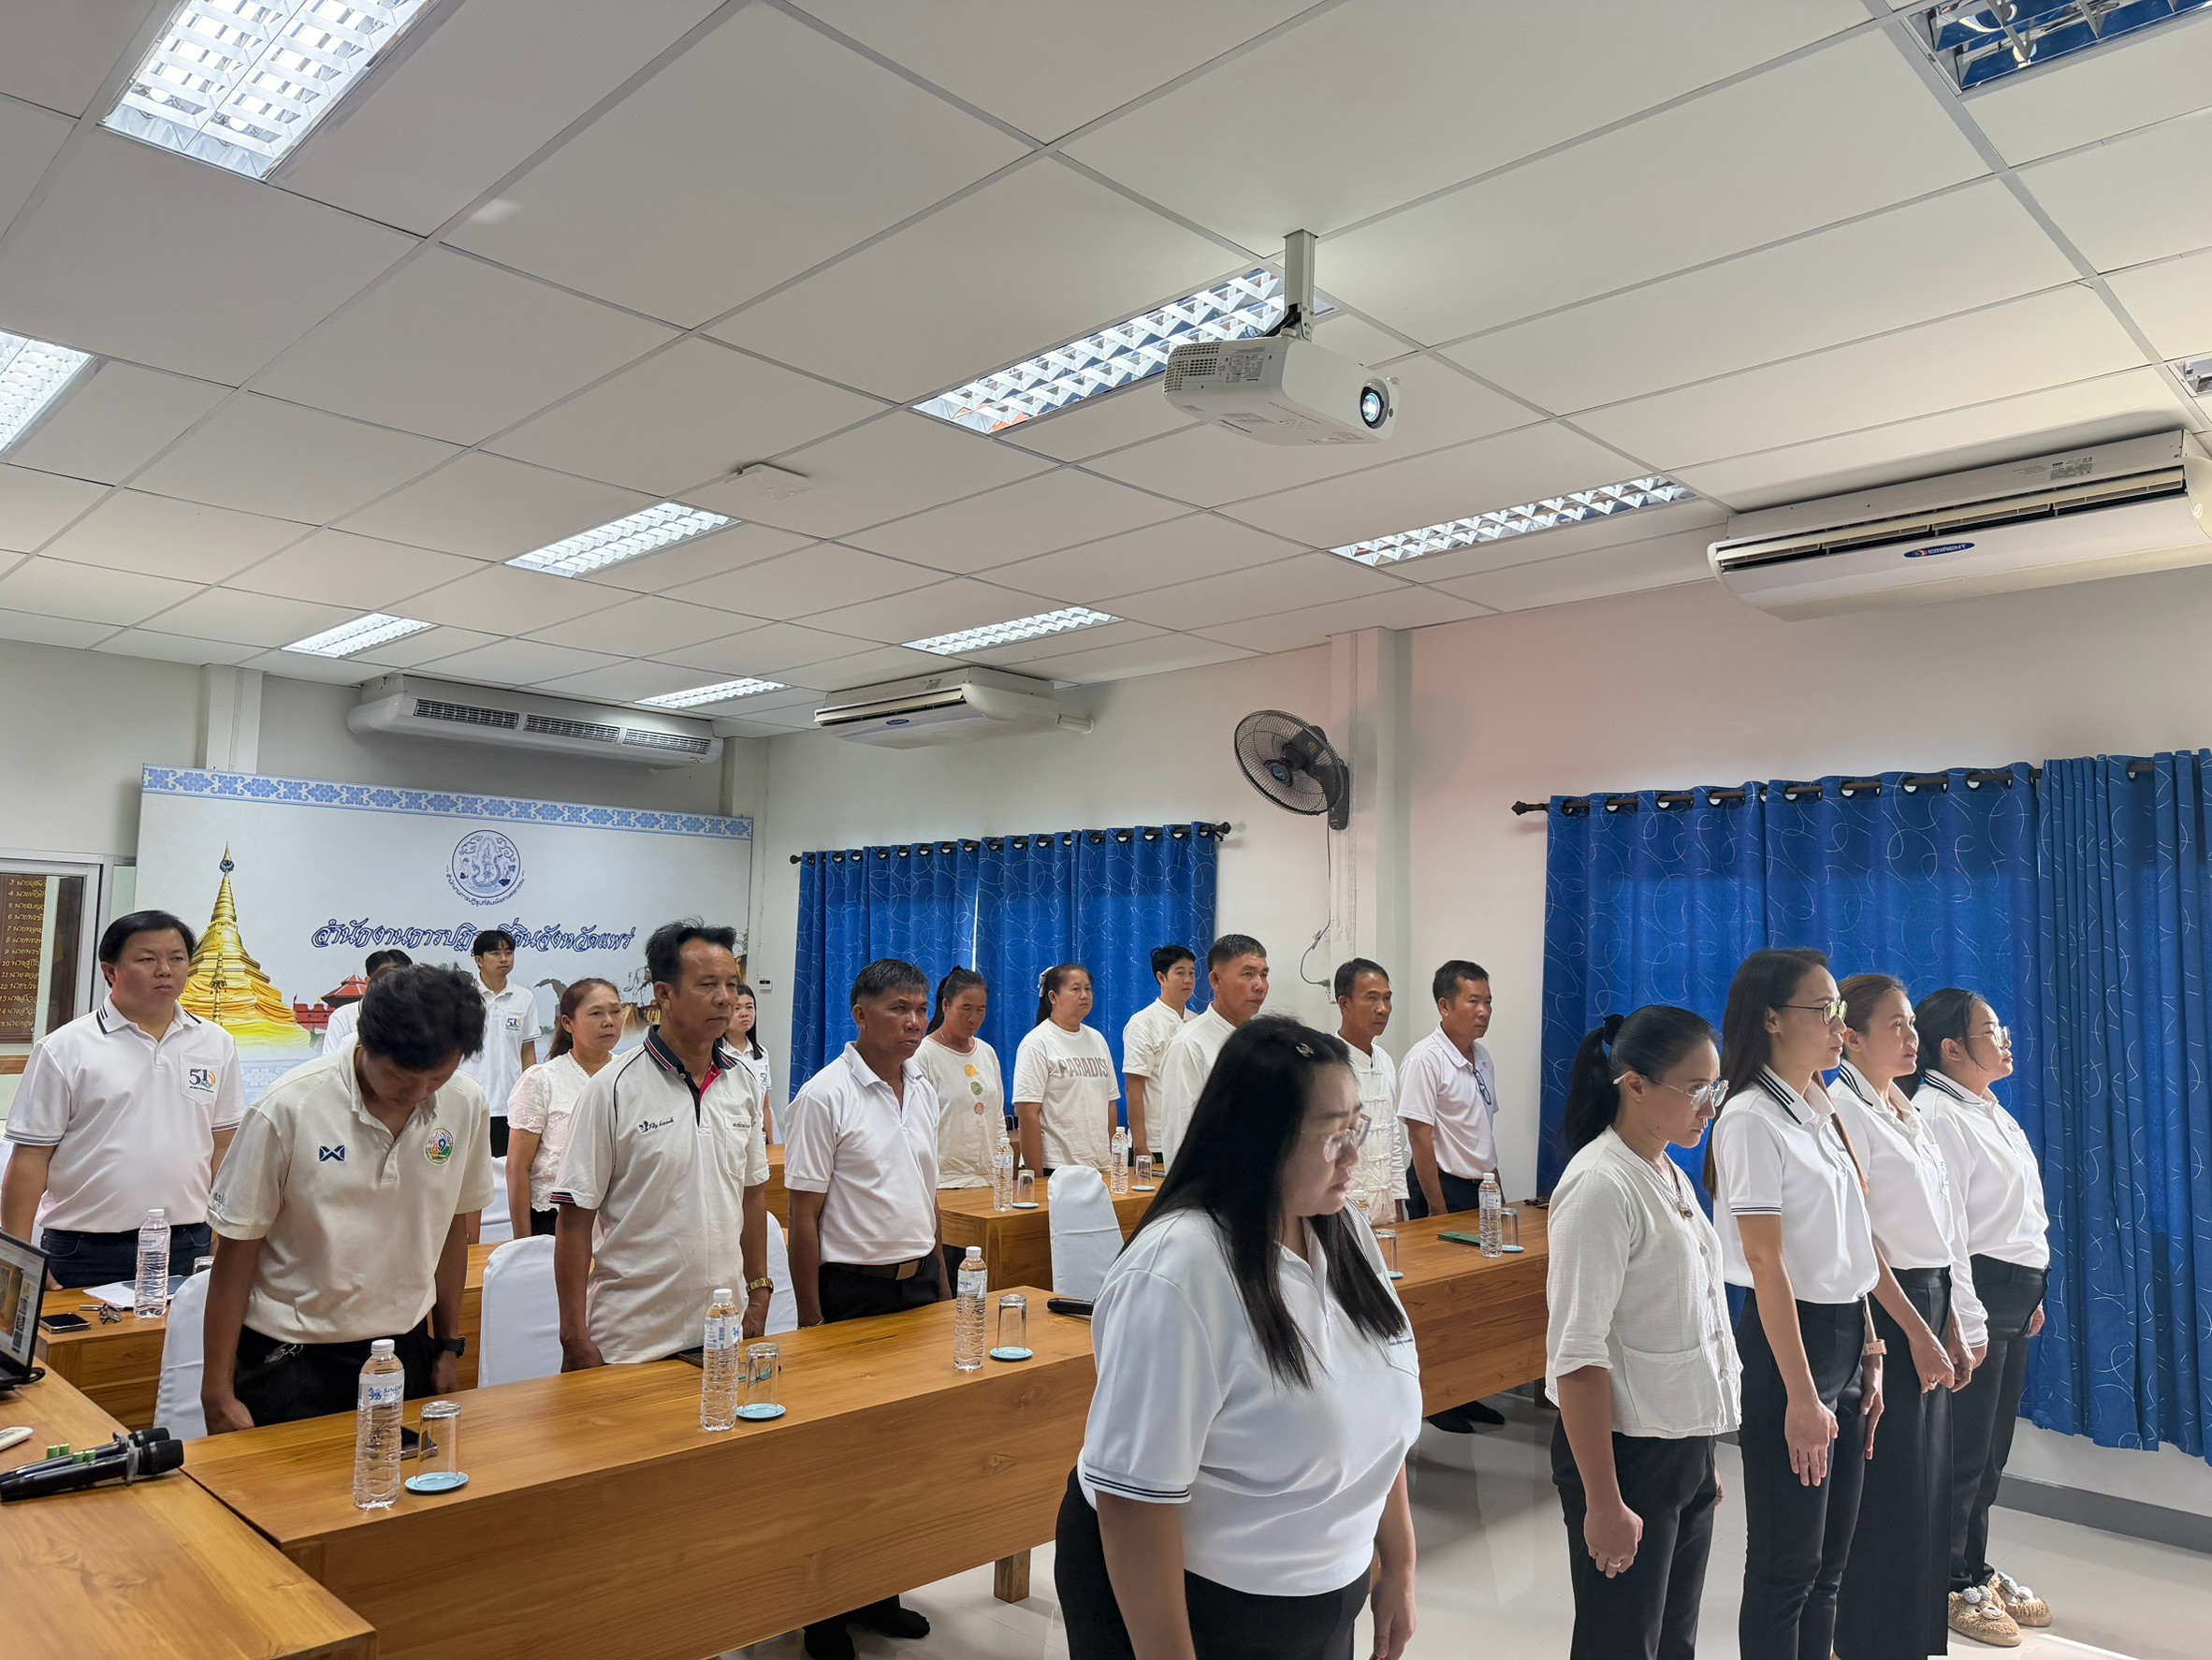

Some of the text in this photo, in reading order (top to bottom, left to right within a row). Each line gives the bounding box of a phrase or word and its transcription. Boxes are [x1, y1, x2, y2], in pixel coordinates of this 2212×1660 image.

[1928, 544, 1967, 555] EMINENT
[1057, 1056, 1110, 1078] PARADIS
[188, 1068, 208, 1085] 51
